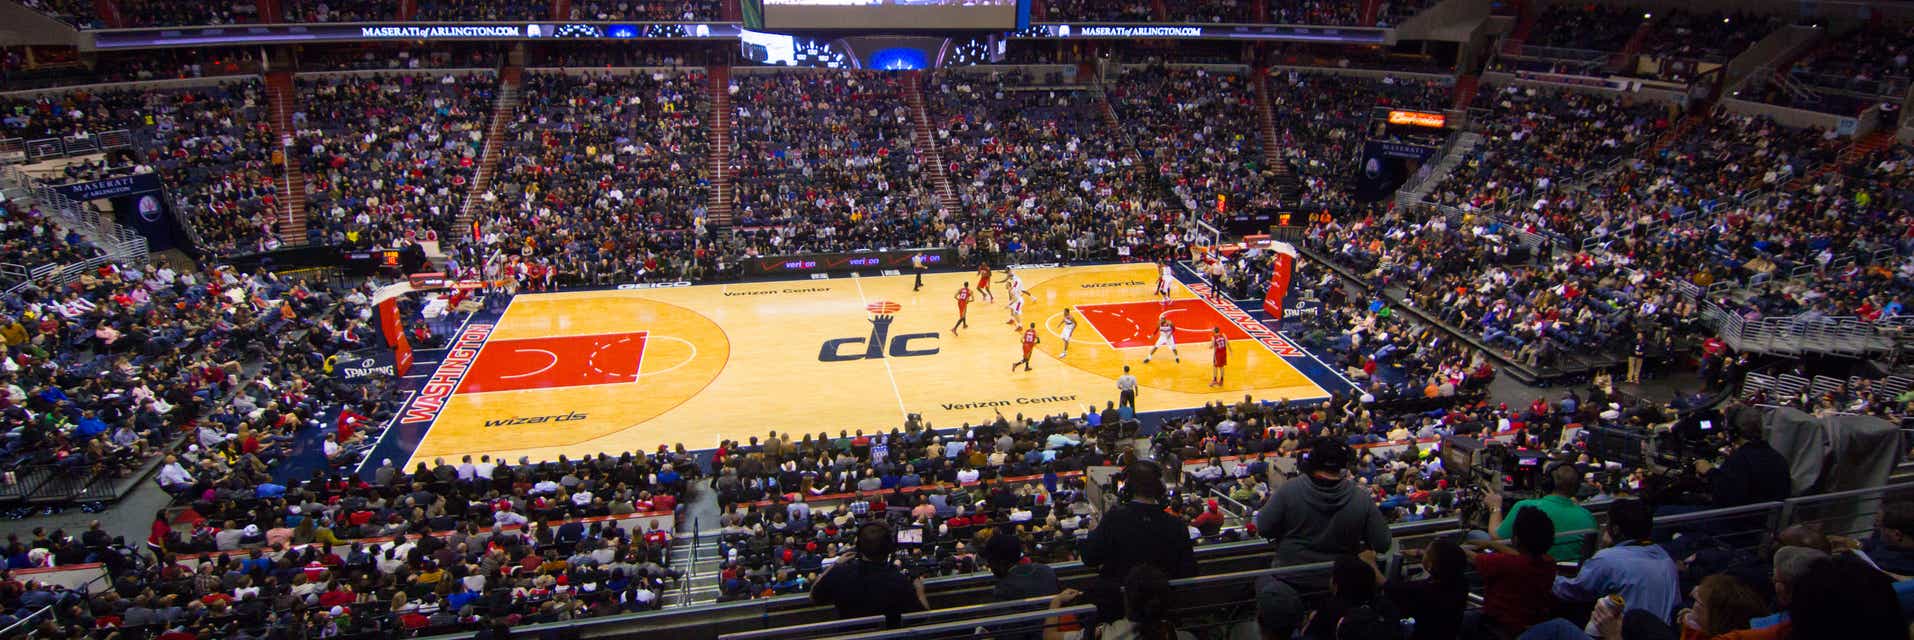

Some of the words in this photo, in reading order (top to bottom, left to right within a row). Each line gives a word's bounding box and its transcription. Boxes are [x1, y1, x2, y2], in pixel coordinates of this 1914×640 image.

[362, 27, 420, 37] MASERATI
[430, 27, 519, 37] ARLINGTON.COM
[1081, 27, 1125, 36] MASERATI
[1132, 27, 1201, 37] ARLINGTON.COM
[73, 177, 133, 192] MASERATI
[850, 257, 879, 266] verizon
[912, 254, 940, 263] vrizon
[785, 260, 816, 269] verizon
[617, 281, 692, 290] GEICO
[1081, 280, 1145, 289] wizards
[723, 289, 777, 297] Verizon
[400, 324, 494, 424] WASHINGTON
[941, 400, 1010, 411] Verizon
[1016, 394, 1077, 405] Center
[484, 411, 588, 427] wizards
